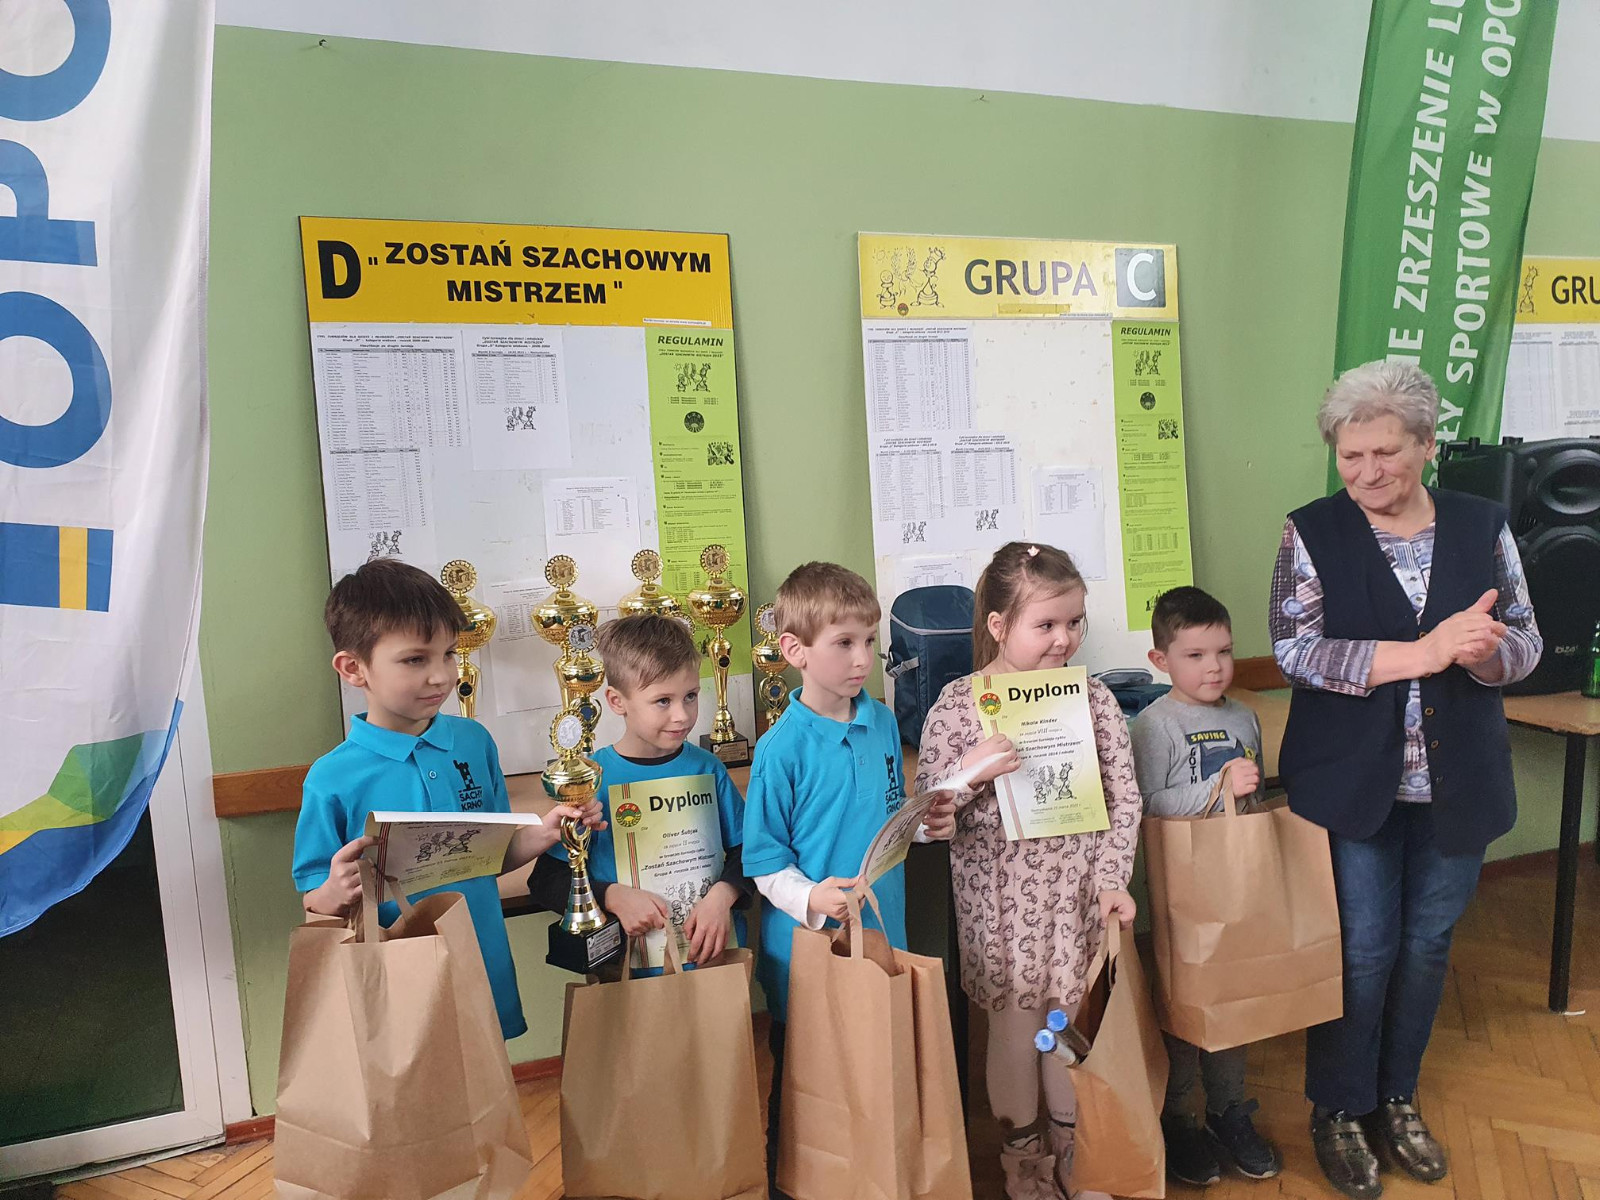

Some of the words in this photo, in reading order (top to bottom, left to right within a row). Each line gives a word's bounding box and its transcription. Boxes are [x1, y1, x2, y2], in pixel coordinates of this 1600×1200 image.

[1393, 48, 1454, 313] ZRZESZENIE
[317, 240, 362, 299] D
[522, 245, 711, 273] SZACHOWYM
[1446, 151, 1492, 384] SPORTOWE
[964, 258, 1098, 297] GRUPA
[1126, 252, 1157, 301] C
[657, 335, 724, 347] REGULAMIN
[1120, 327, 1171, 337] REGULAMIN
[1386, 327, 1424, 365] IE
[1008, 683, 1080, 704] Dyplom
[1190, 731, 1226, 743] SAVING
[649, 790, 713, 813] Dyplom
